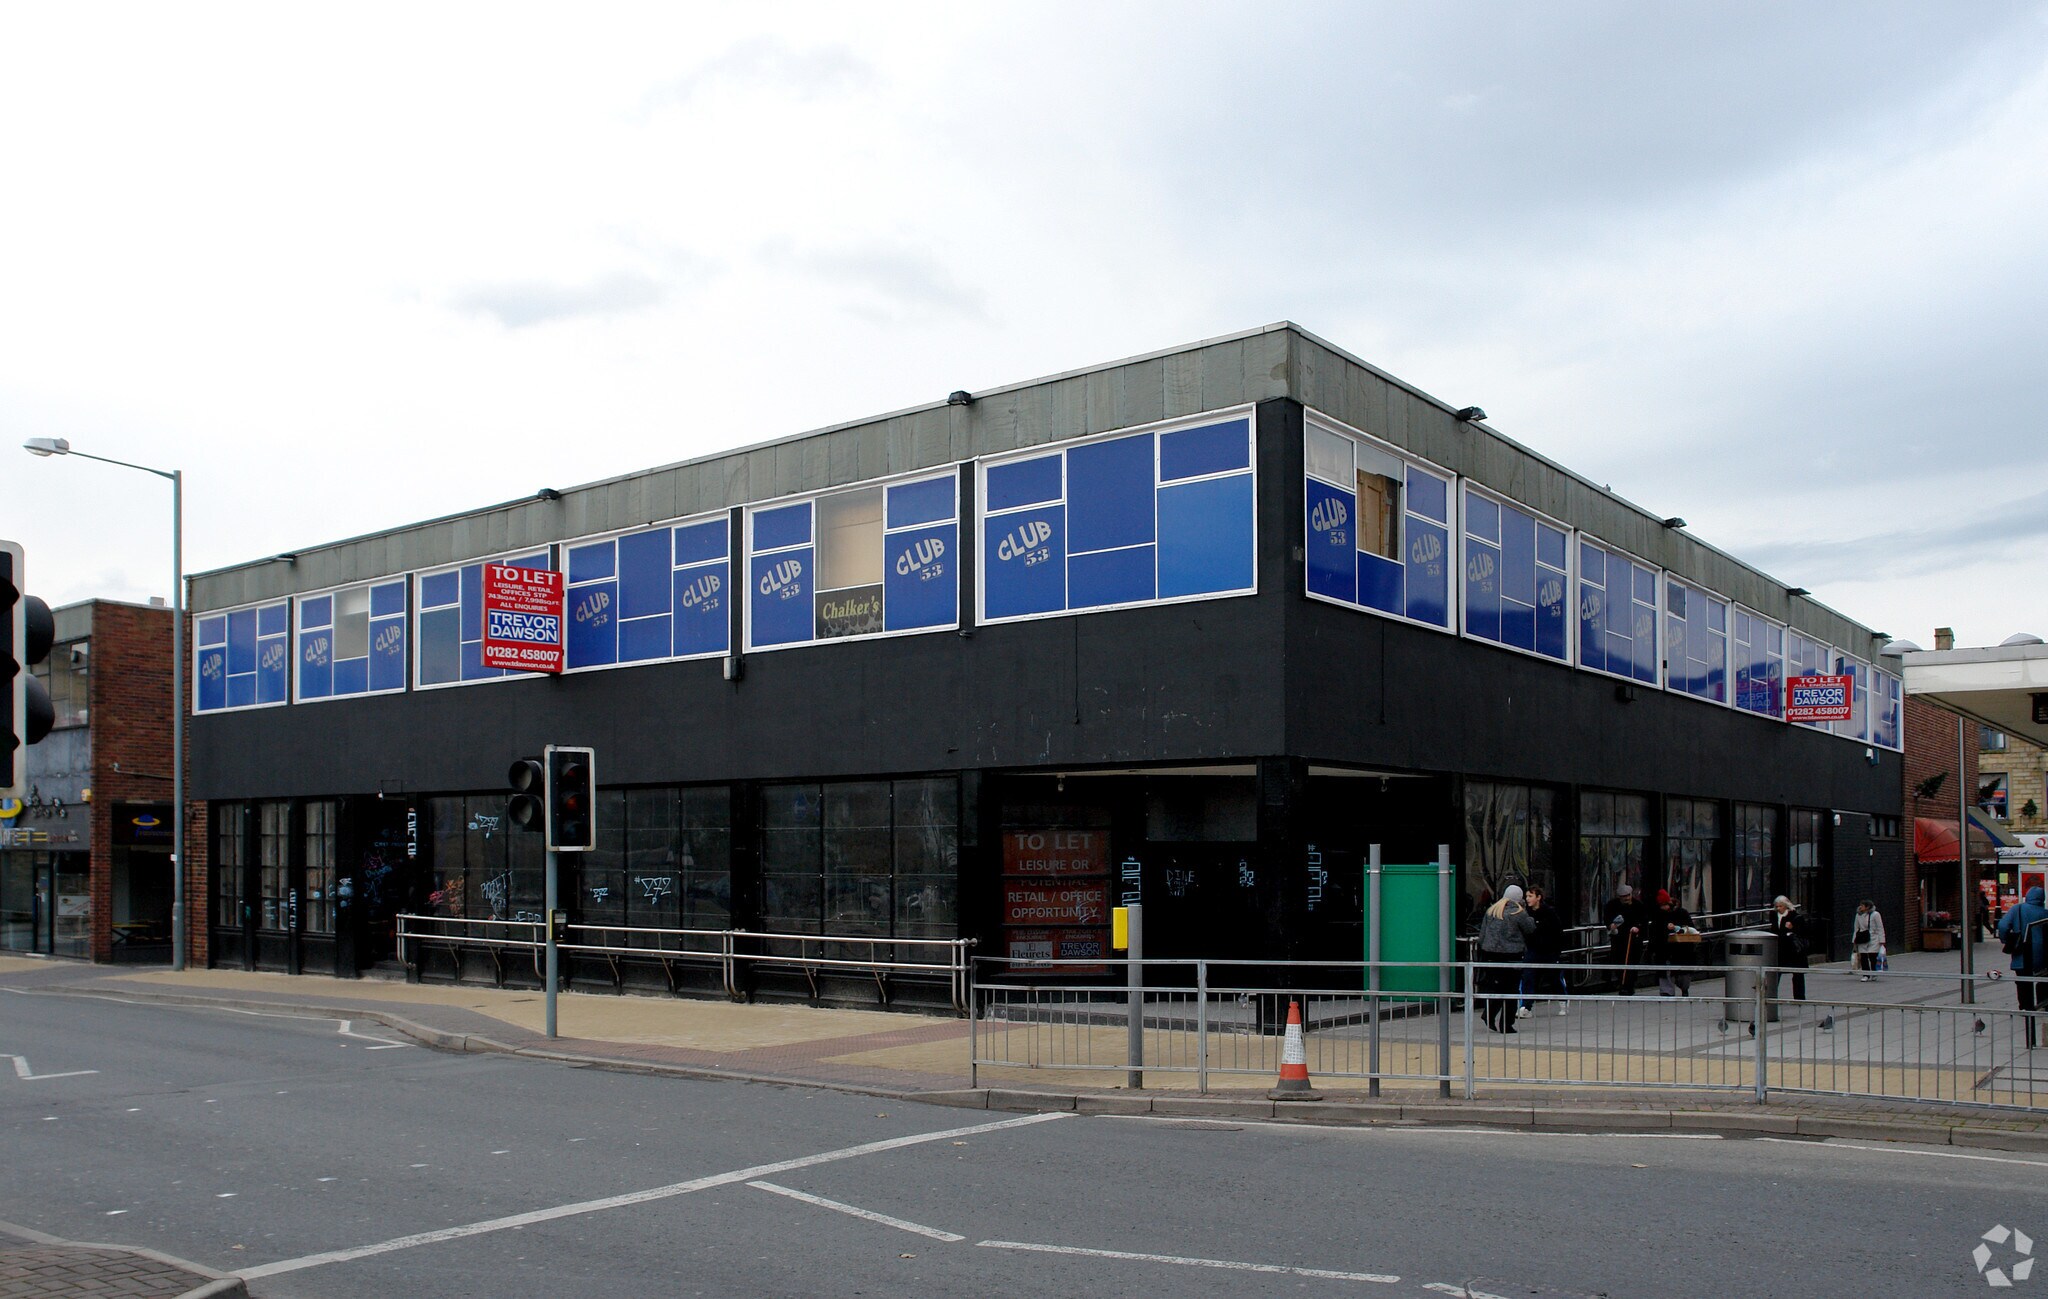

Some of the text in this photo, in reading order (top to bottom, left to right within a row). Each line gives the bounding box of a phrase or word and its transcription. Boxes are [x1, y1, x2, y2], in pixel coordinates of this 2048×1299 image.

[1312, 498, 1347, 532] CLUB
[998, 521, 1052, 561] CLUB
[1330, 531, 1346, 545] 53
[896, 538, 945, 576] CLUB
[1026, 548, 1049, 566] 53
[1412, 533, 1441, 564] CLUB
[492, 566, 556, 585] TO LET
[921, 563, 943, 581] 53
[1427, 564, 1440, 576] 53
[1468, 552, 1494, 582] CLUB
[760, 559, 802, 595] CLUB
[501, 589, 531, 597] OFFICES
[682, 575, 721, 608] CLUB
[781, 583, 800, 599] 53
[1541, 580, 1562, 608] CLUB
[514, 603, 548, 612] ENQUIRIES
[576, 592, 610, 622] CLUB
[702, 598, 719, 612] 53
[822, 595, 880, 620] Chalker's
[1551, 606, 1561, 617] 53
[1581, 594, 1600, 620] CLUB
[491, 612, 556, 630] TREVOR
[592, 614, 608, 627] 53
[376, 625, 400, 651] CLUB
[491, 624, 557, 642] DAWSON
[262, 644, 283, 668] CLUB
[306, 637, 328, 662] CLUB
[388, 645, 400, 656] 53
[486, 646, 560, 661] 01282 458007
[202, 653, 222, 677] CLUB
[317, 656, 327, 666] 53
[1794, 696, 1843, 705] DAWSON
[1795, 689, 1843, 697] TREVOR
[1815, 707, 1849, 715] 458007
[1015, 833, 1093, 850] TO LET
[1020, 859, 1089, 871] LEISURE OR
[1008, 890, 1102, 903] RETAIL / OFFICE
[1012, 906, 1098, 919] OPPORTUNITY
[1060, 942, 1099, 950] TREVOR
[1061, 949, 1100, 957] DAWSON
